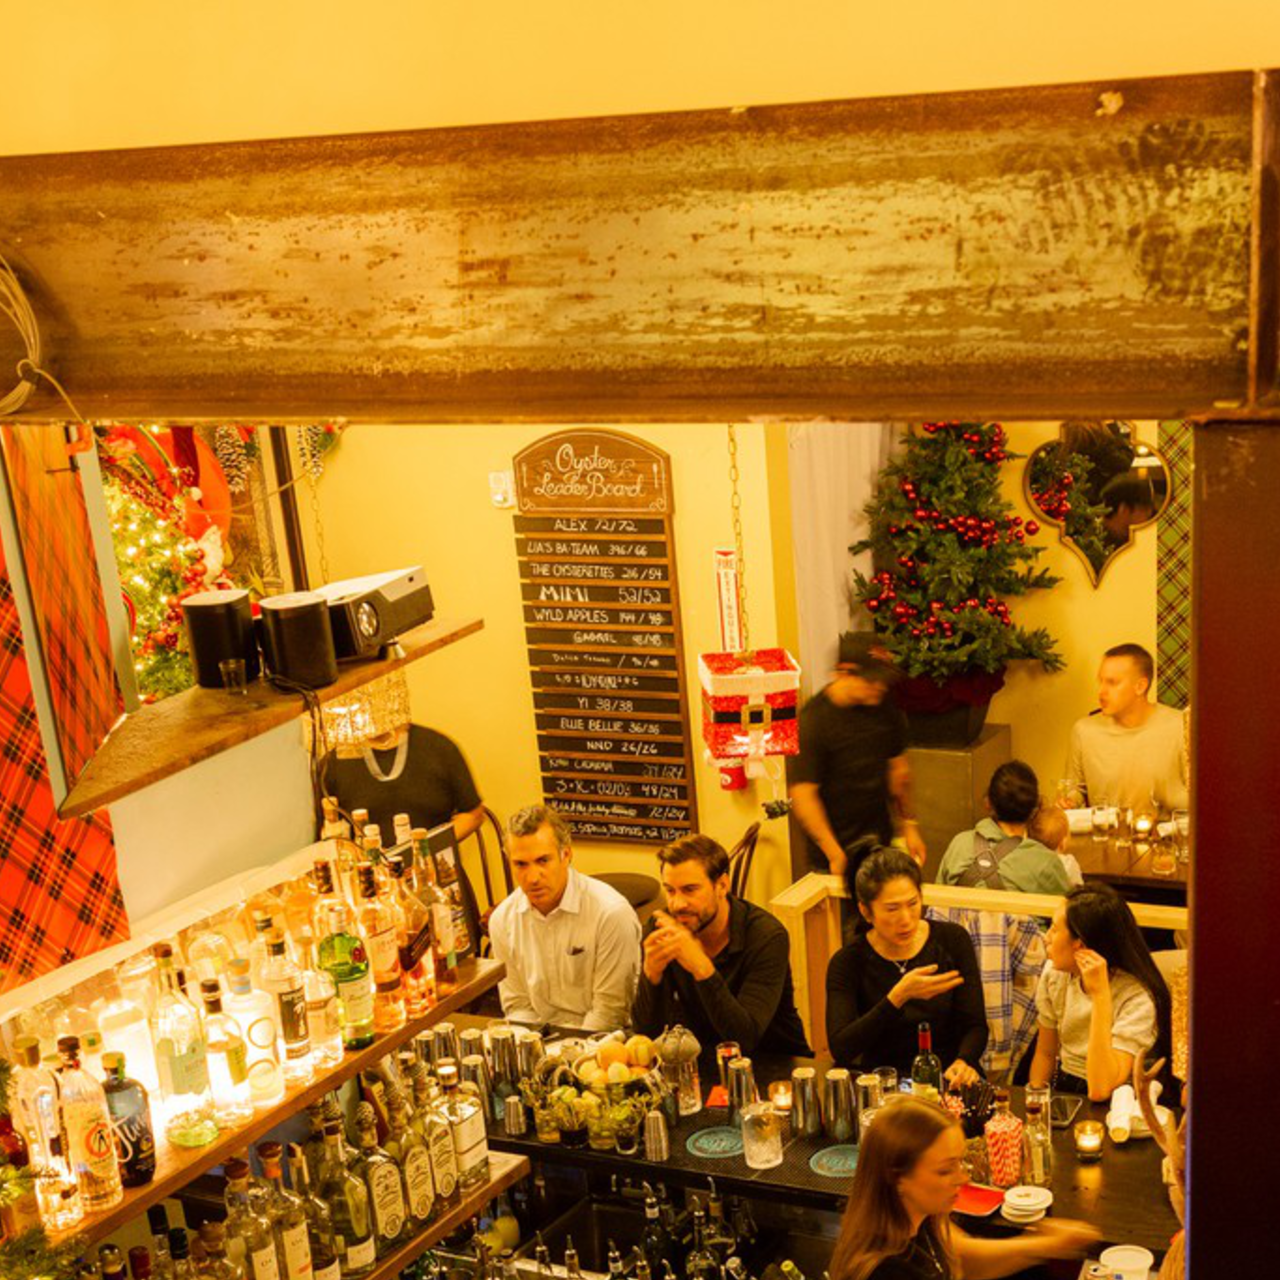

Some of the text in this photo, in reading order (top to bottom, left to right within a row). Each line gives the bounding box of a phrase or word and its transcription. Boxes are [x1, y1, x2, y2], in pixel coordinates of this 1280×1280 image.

[555, 443, 617, 483] Oyster
[554, 519, 638, 533] ALEX 72/72
[530, 563, 550, 576] THE
[716, 558, 734, 568] FIRE
[538, 586, 661, 604] MIMI 52/52
[533, 608, 563, 621] WYLD
[566, 609, 609, 623] APPLES
[577, 697, 634, 712] YI 38/38
[620, 741, 658, 756] 26/26
